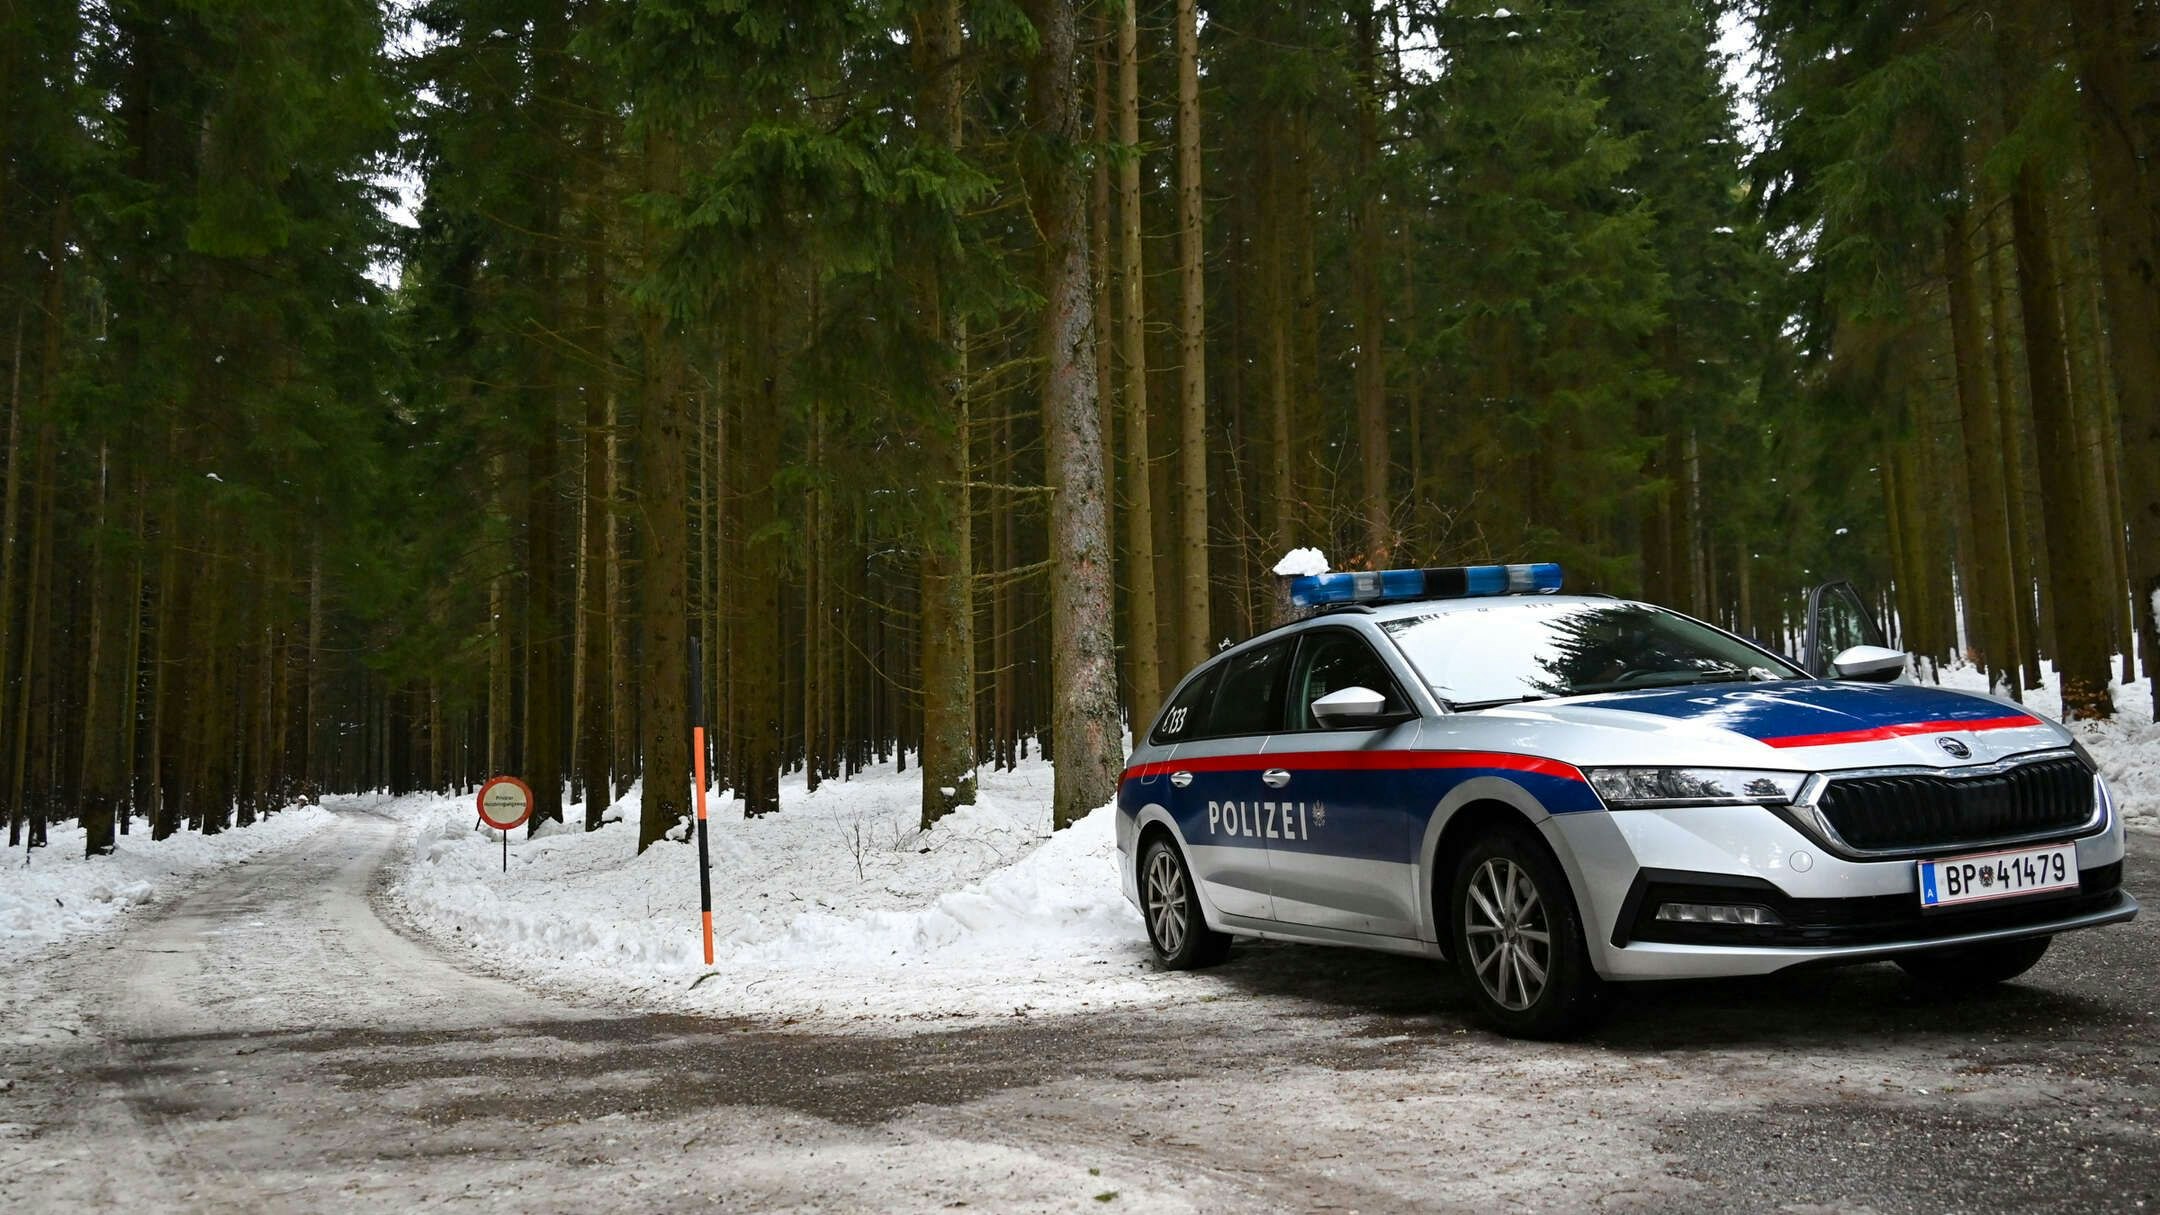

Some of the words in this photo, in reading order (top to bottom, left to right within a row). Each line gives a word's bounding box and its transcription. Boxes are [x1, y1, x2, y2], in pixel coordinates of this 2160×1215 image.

[1168, 706, 1188, 734] 133
[1208, 800, 1308, 841] POLIZEI
[1946, 864, 1976, 895] BP
[1997, 852, 2066, 888] 41479
[1927, 888, 1934, 898] A
